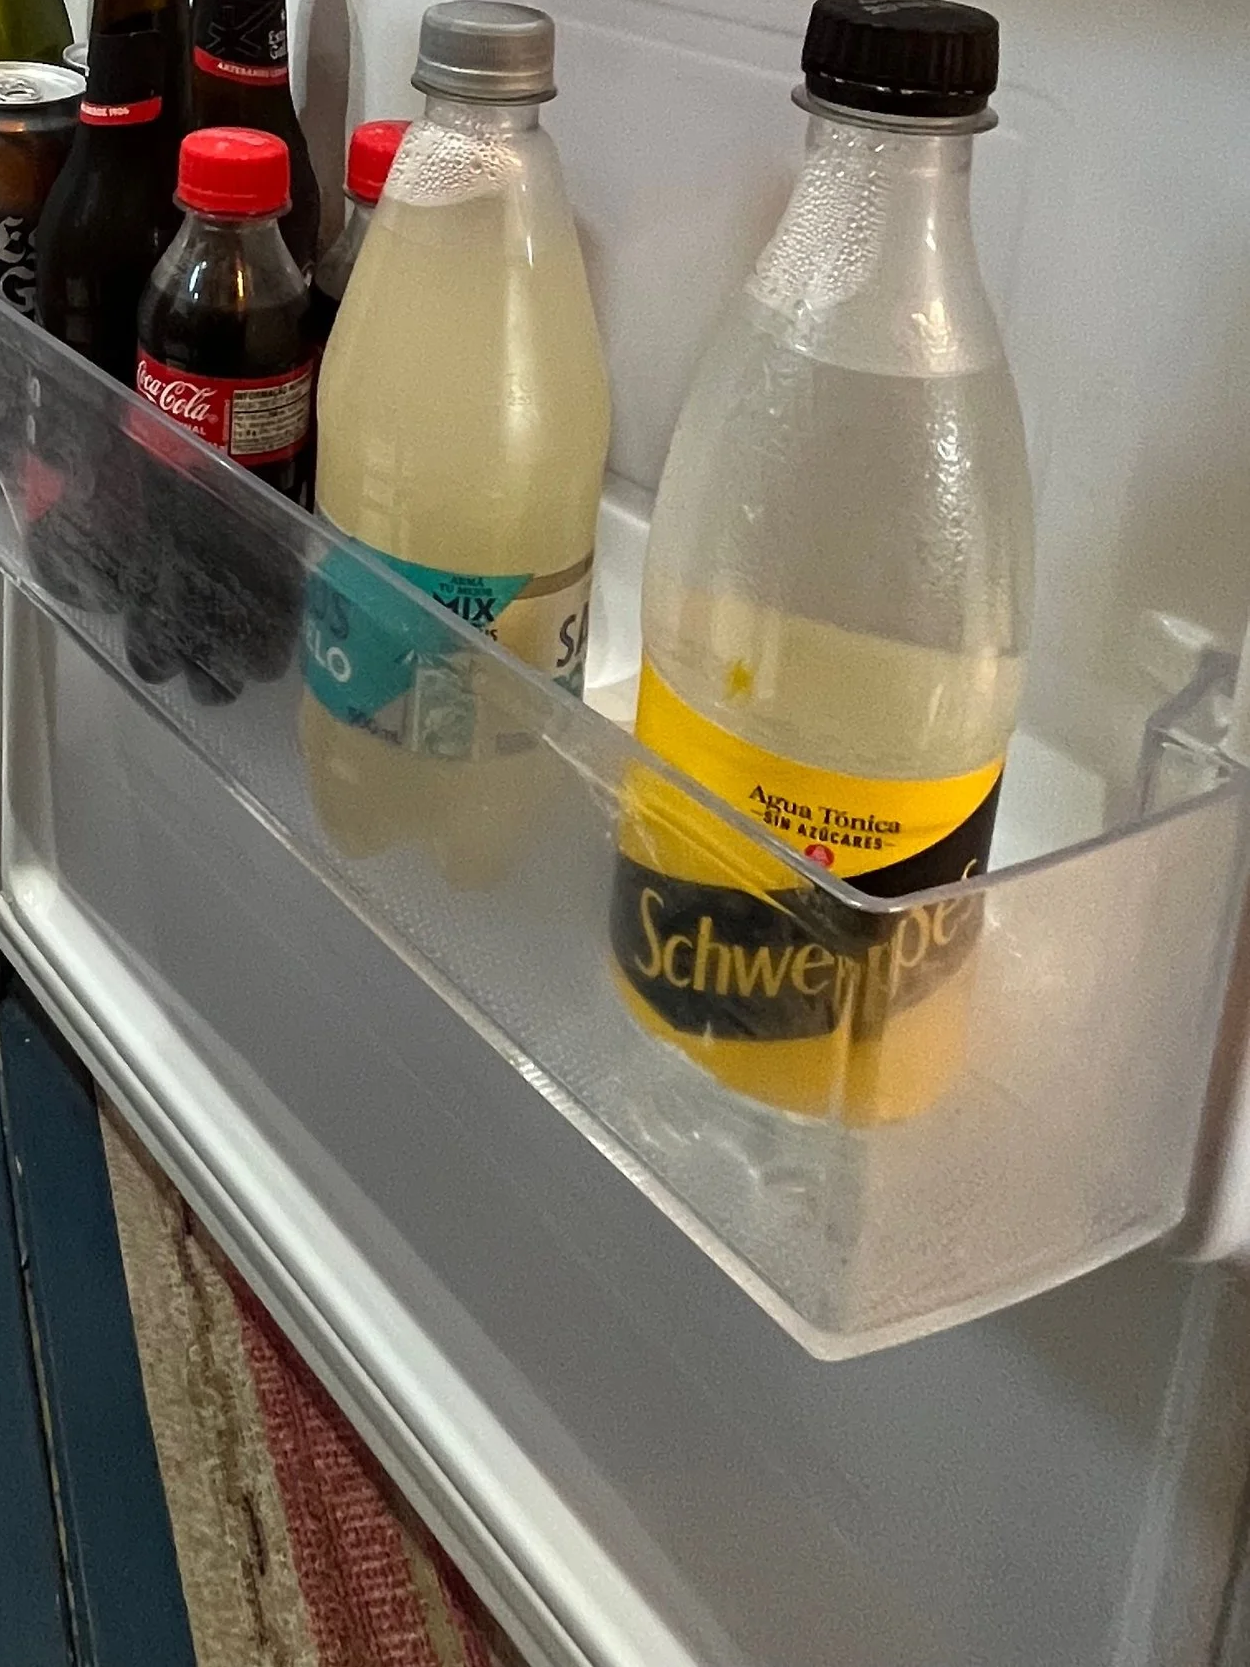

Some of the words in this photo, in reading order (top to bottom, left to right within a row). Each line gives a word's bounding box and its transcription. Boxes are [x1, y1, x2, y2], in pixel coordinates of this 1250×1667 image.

[432, 591, 498, 622] MIX
[748, 784, 814, 821] Agua
[818, 805, 902, 834] Tónica
[762, 810, 791, 830] SIN
[797, 823, 883, 850] AZÚCARES
